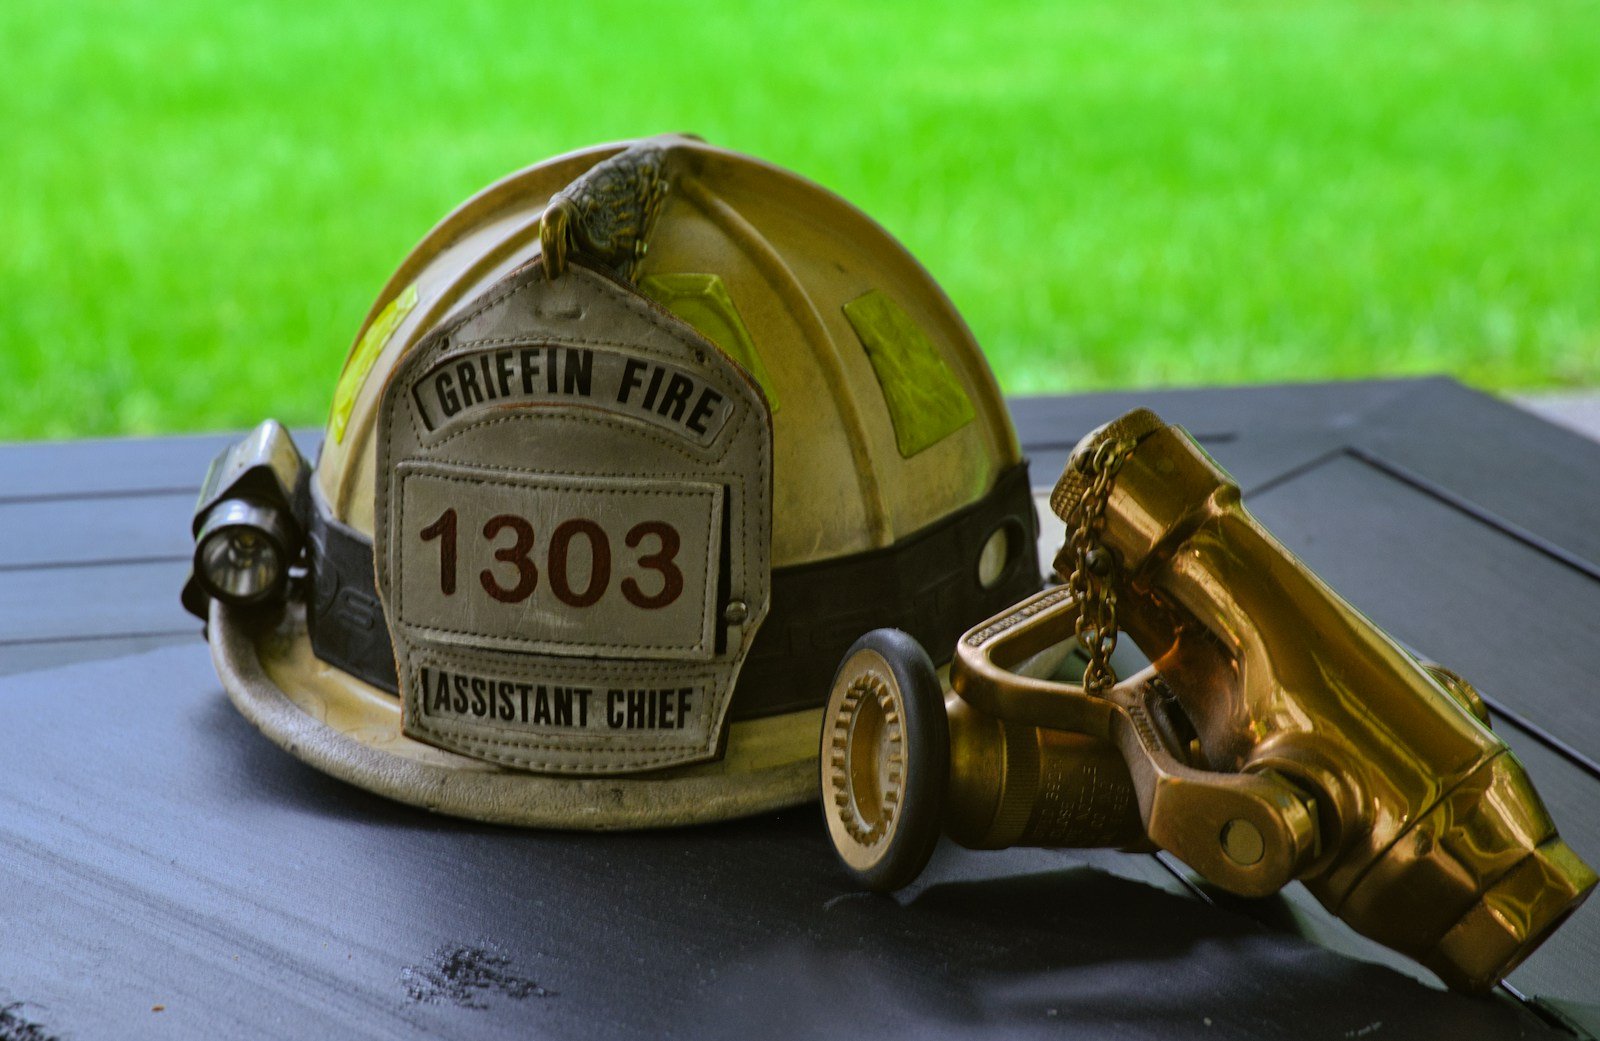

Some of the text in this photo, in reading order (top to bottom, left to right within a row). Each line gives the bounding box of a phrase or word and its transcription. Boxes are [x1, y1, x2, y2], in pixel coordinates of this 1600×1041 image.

[435, 348, 723, 435] GRIFFIN FIRE
[420, 508, 684, 610] 1303
[434, 672, 694, 729] ASSISTANT CHIEF
